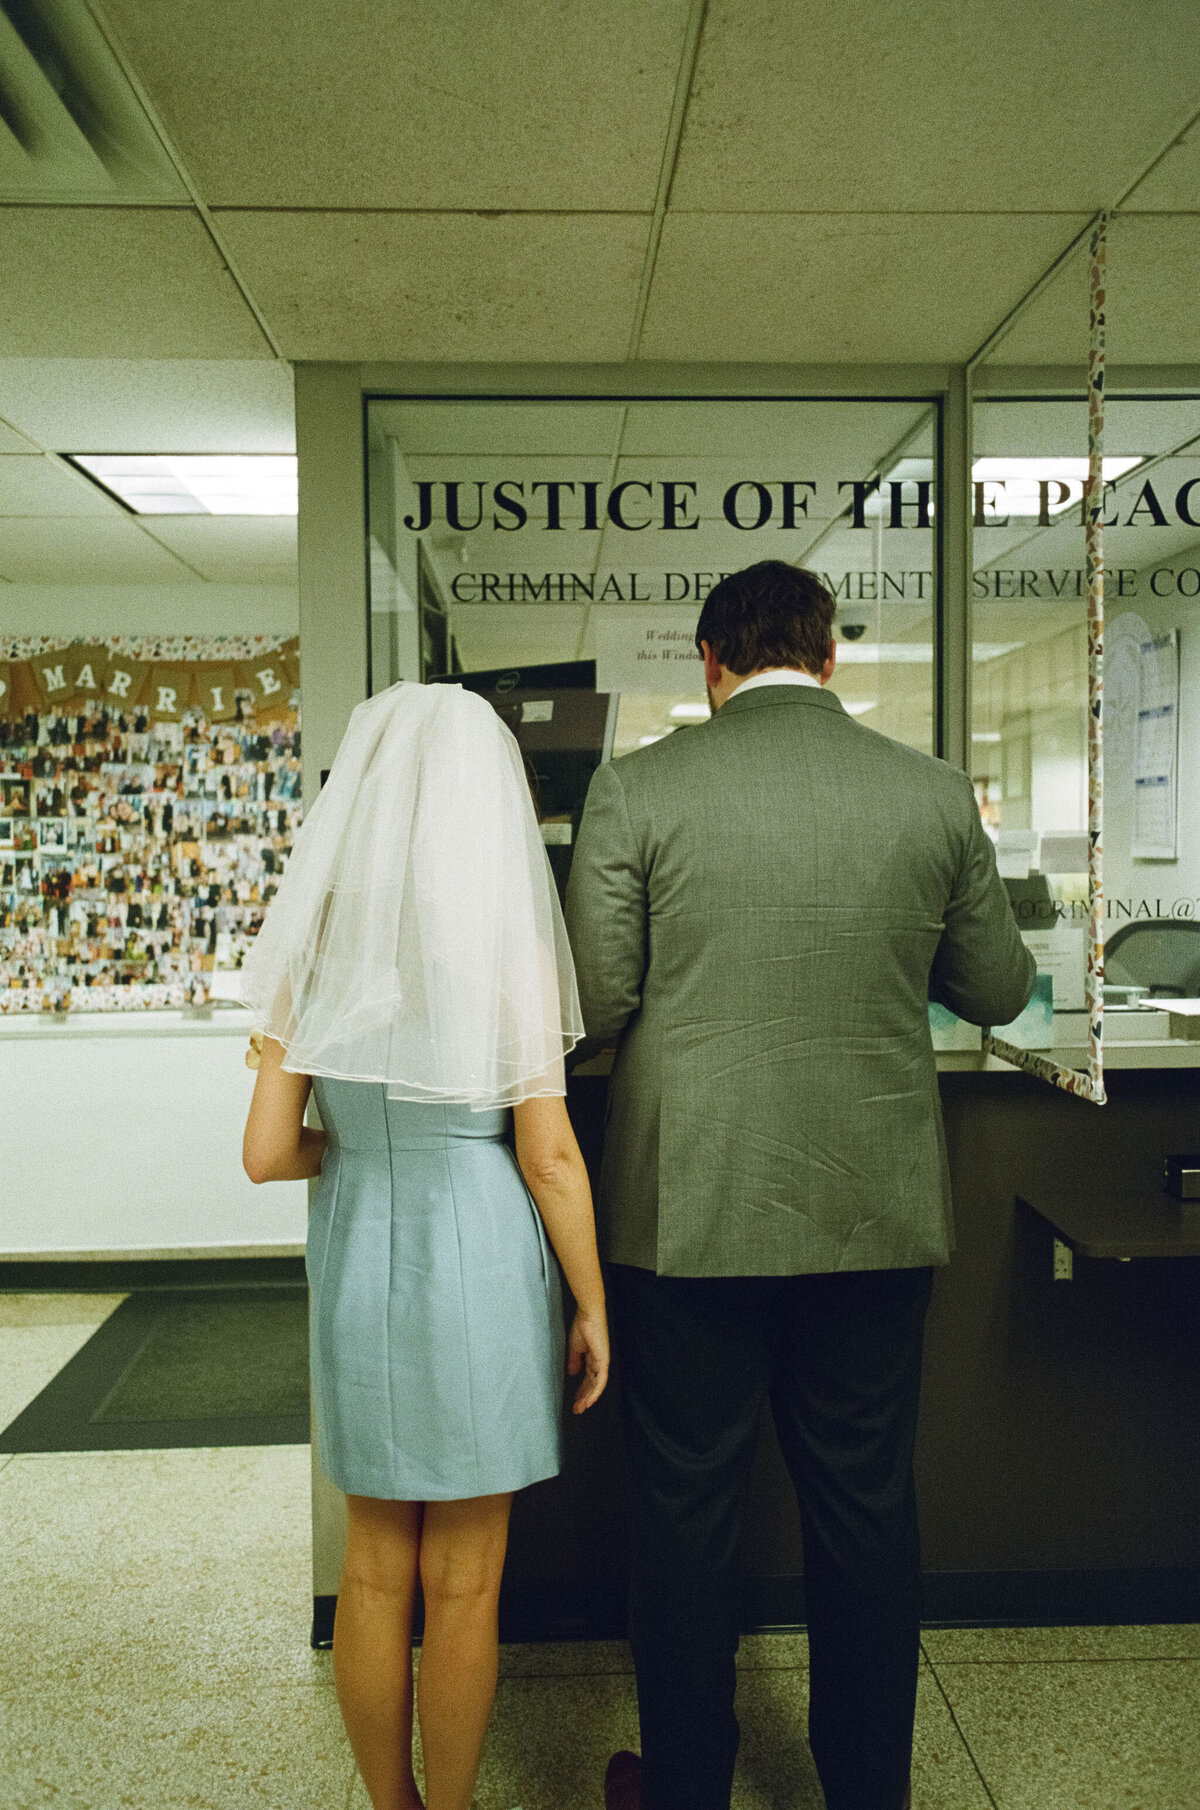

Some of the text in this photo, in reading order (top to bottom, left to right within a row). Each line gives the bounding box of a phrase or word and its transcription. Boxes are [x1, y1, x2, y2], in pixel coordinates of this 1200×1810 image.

[403, 480, 700, 531] JUSTICE
[723, 480, 817, 531] OF
[838, 480, 1009, 528] THE
[451, 572, 652, 602] CRIMINAL
[663, 571, 933, 602] DEMENT
[1150, 567, 1200, 597] CO
[636, 648, 704, 661] this Windo
[42, 662, 282, 713] MARRIE
